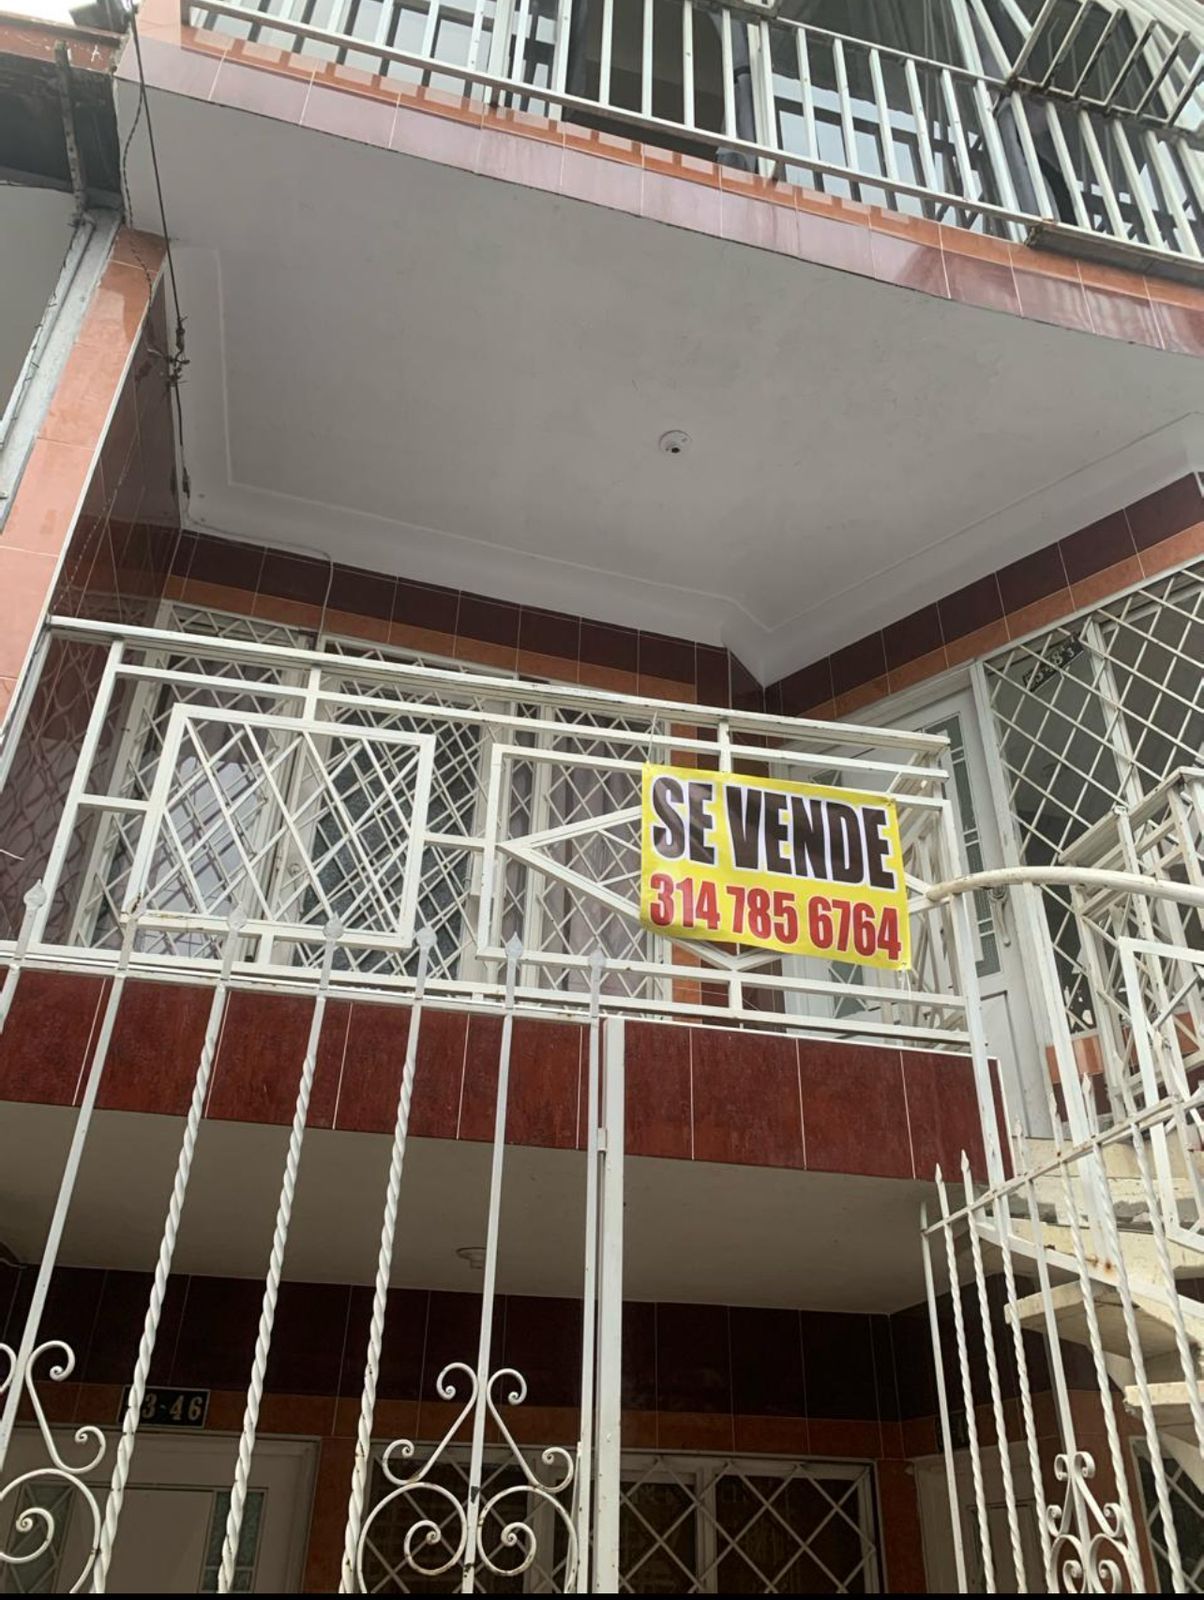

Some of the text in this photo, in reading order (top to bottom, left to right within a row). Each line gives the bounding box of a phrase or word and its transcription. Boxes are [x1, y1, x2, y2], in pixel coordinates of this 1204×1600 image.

[651, 776, 896, 889] SE VENDE
[650, 874, 902, 961] 314 785 6764
[127, 1393, 203, 1421] 3-46
